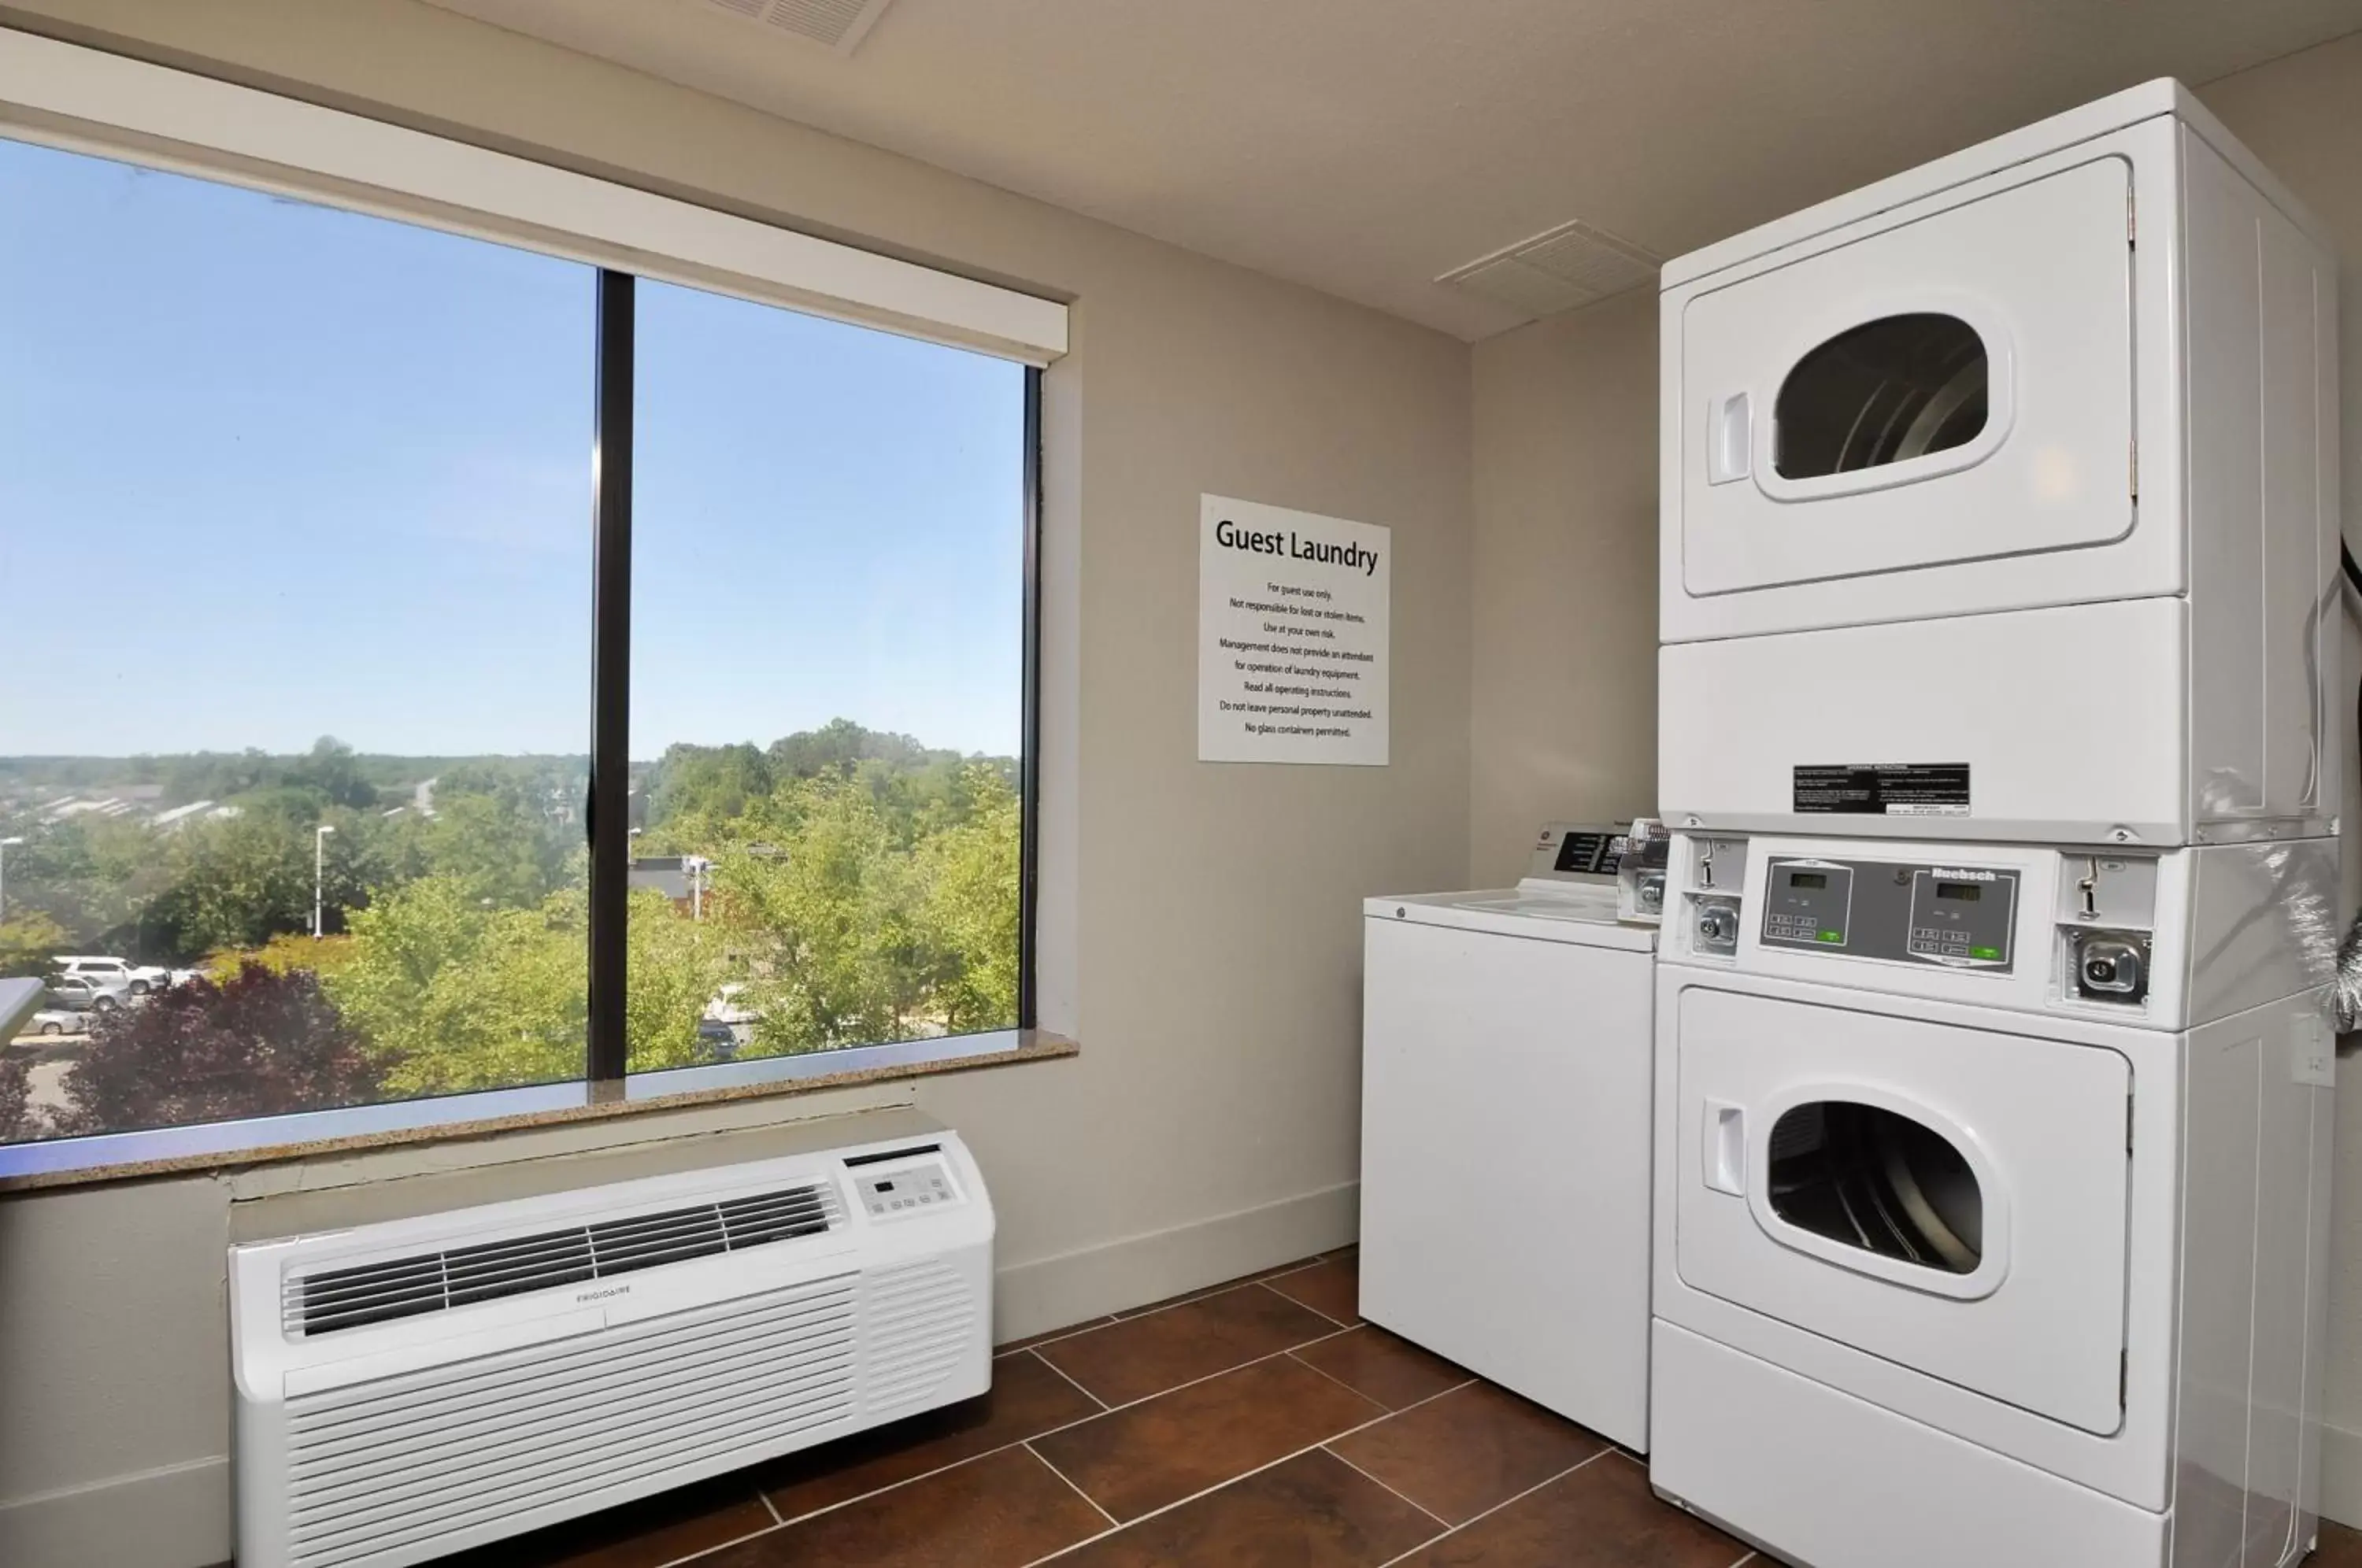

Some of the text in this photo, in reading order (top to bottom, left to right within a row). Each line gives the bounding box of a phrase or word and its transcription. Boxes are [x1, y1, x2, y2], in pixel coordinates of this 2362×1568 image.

[1216, 520, 1378, 576] Guest Laundry
[1267, 582, 1331, 602] For guest use only.
[1230, 597, 1244, 608] Not
[1245, 601, 1288, 614] responsible
[1289, 604, 1298, 615] for
[1300, 605, 1313, 617] lost
[1324, 610, 1344, 621] stolen
[1346, 612, 1365, 623] items.
[1264, 621, 1277, 632] Use
[1287, 627, 1303, 637] your
[1305, 629, 1320, 638] own
[1321, 629, 1336, 639] risk.
[1220, 637, 1270, 653] Management
[1271, 642, 1289, 653] does
[1290, 645, 1303, 656] not
[1304, 648, 1330, 659] provide
[1234, 659, 1361, 681] for operation of laundry equipment.
[1244, 681, 1352, 699] Read all operating instructions.
[1220, 700, 1372, 719] Do not leave personal property unattended.
[1245, 722, 1350, 738] No glass containers permitted.
[576, 1285, 630, 1303] FRIGIDAIRE
